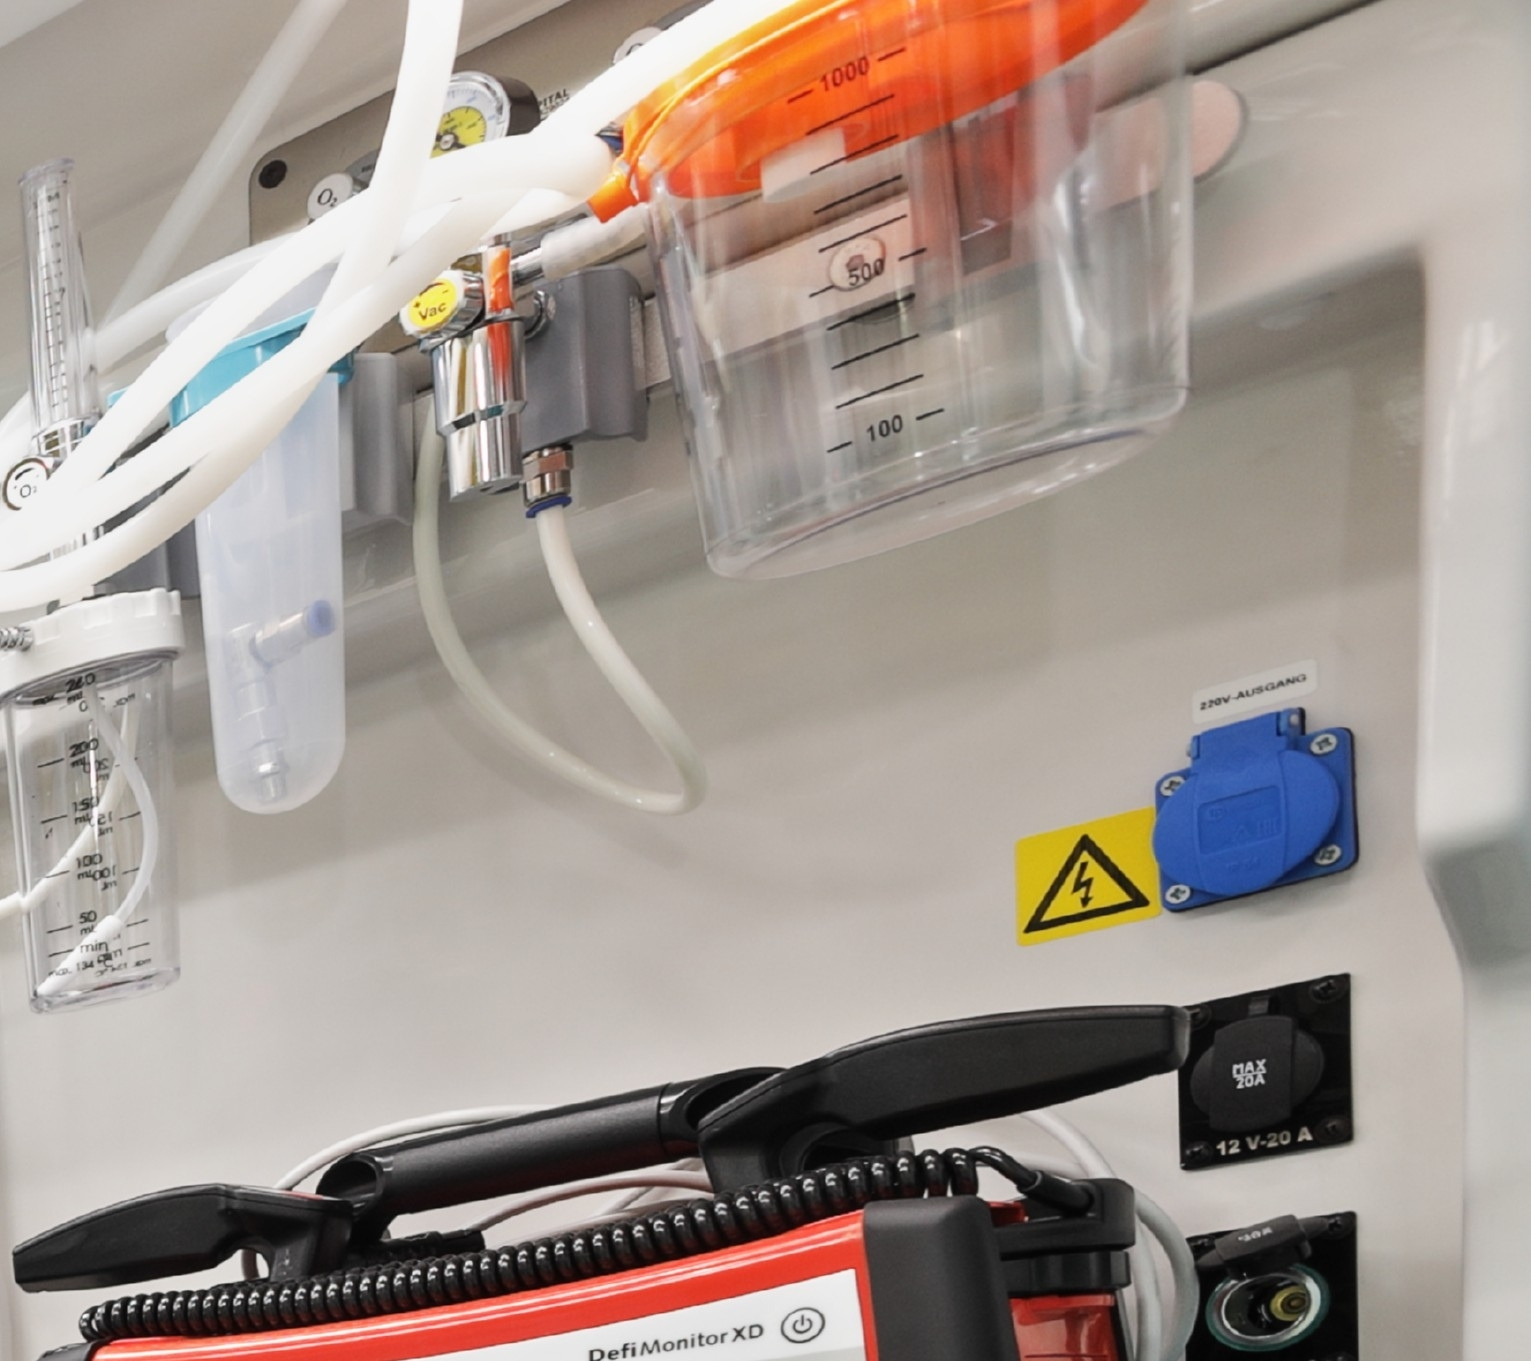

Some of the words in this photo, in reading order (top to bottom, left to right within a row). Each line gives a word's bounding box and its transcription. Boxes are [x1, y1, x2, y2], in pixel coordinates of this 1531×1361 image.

[820, 56, 870, 93] 1000
[849, 258, 884, 286] 500
[418, 301, 447, 321] Vac
[866, 414, 903, 442] 100
[1200, 674, 1307, 711] 220V-AUSGANG
[76, 853, 103, 868] 100
[79, 910, 97, 924] 50
[79, 940, 109, 953] min
[1232, 1059, 1267, 1078] MAX
[1236, 1073, 1266, 1089] 20A
[1216, 1141, 1241, 1157] 12
[1245, 1131, 1293, 1153] V-20
[1296, 1125, 1314, 1142] A
[731, 1323, 765, 1343] XD
